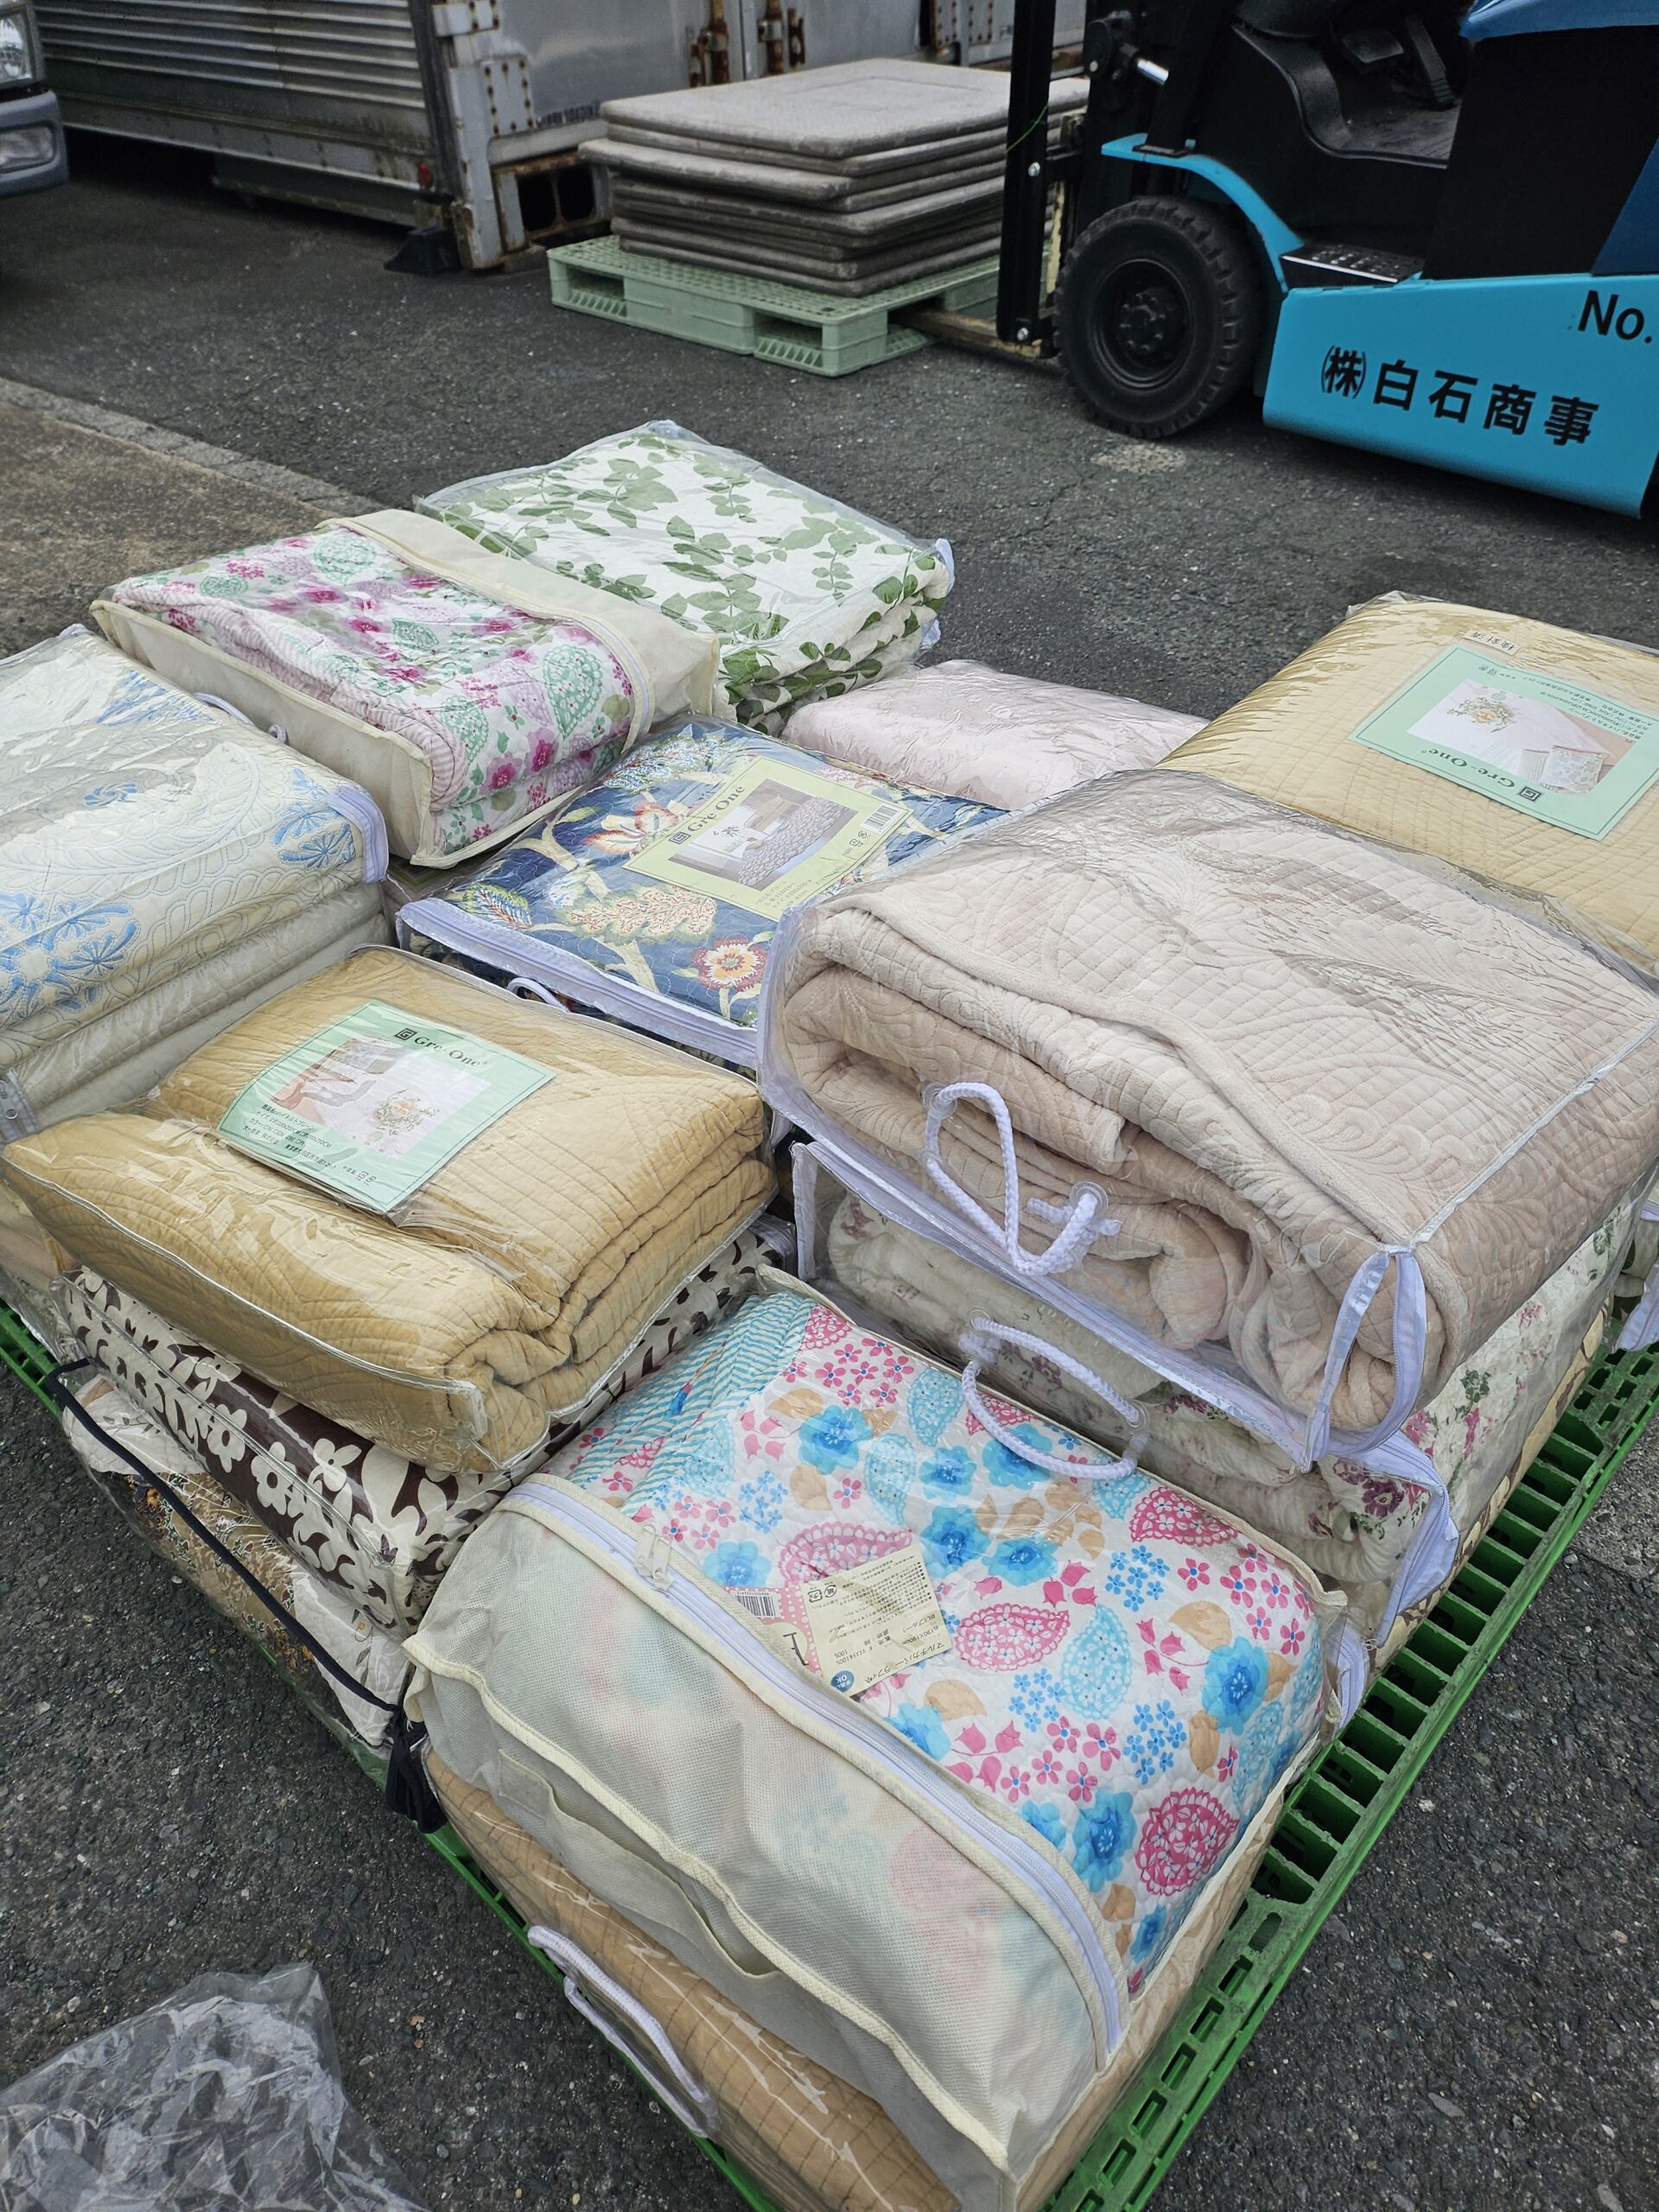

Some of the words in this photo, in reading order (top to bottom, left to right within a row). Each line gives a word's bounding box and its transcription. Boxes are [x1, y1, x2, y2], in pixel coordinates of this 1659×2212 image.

[1578, 289, 1652, 344] No.
[687, 810, 717, 834] Gre
[715, 785, 746, 810] One
[894, 1643, 944, 1667] マルチカバー
[836, 1674, 847, 1682] OK
